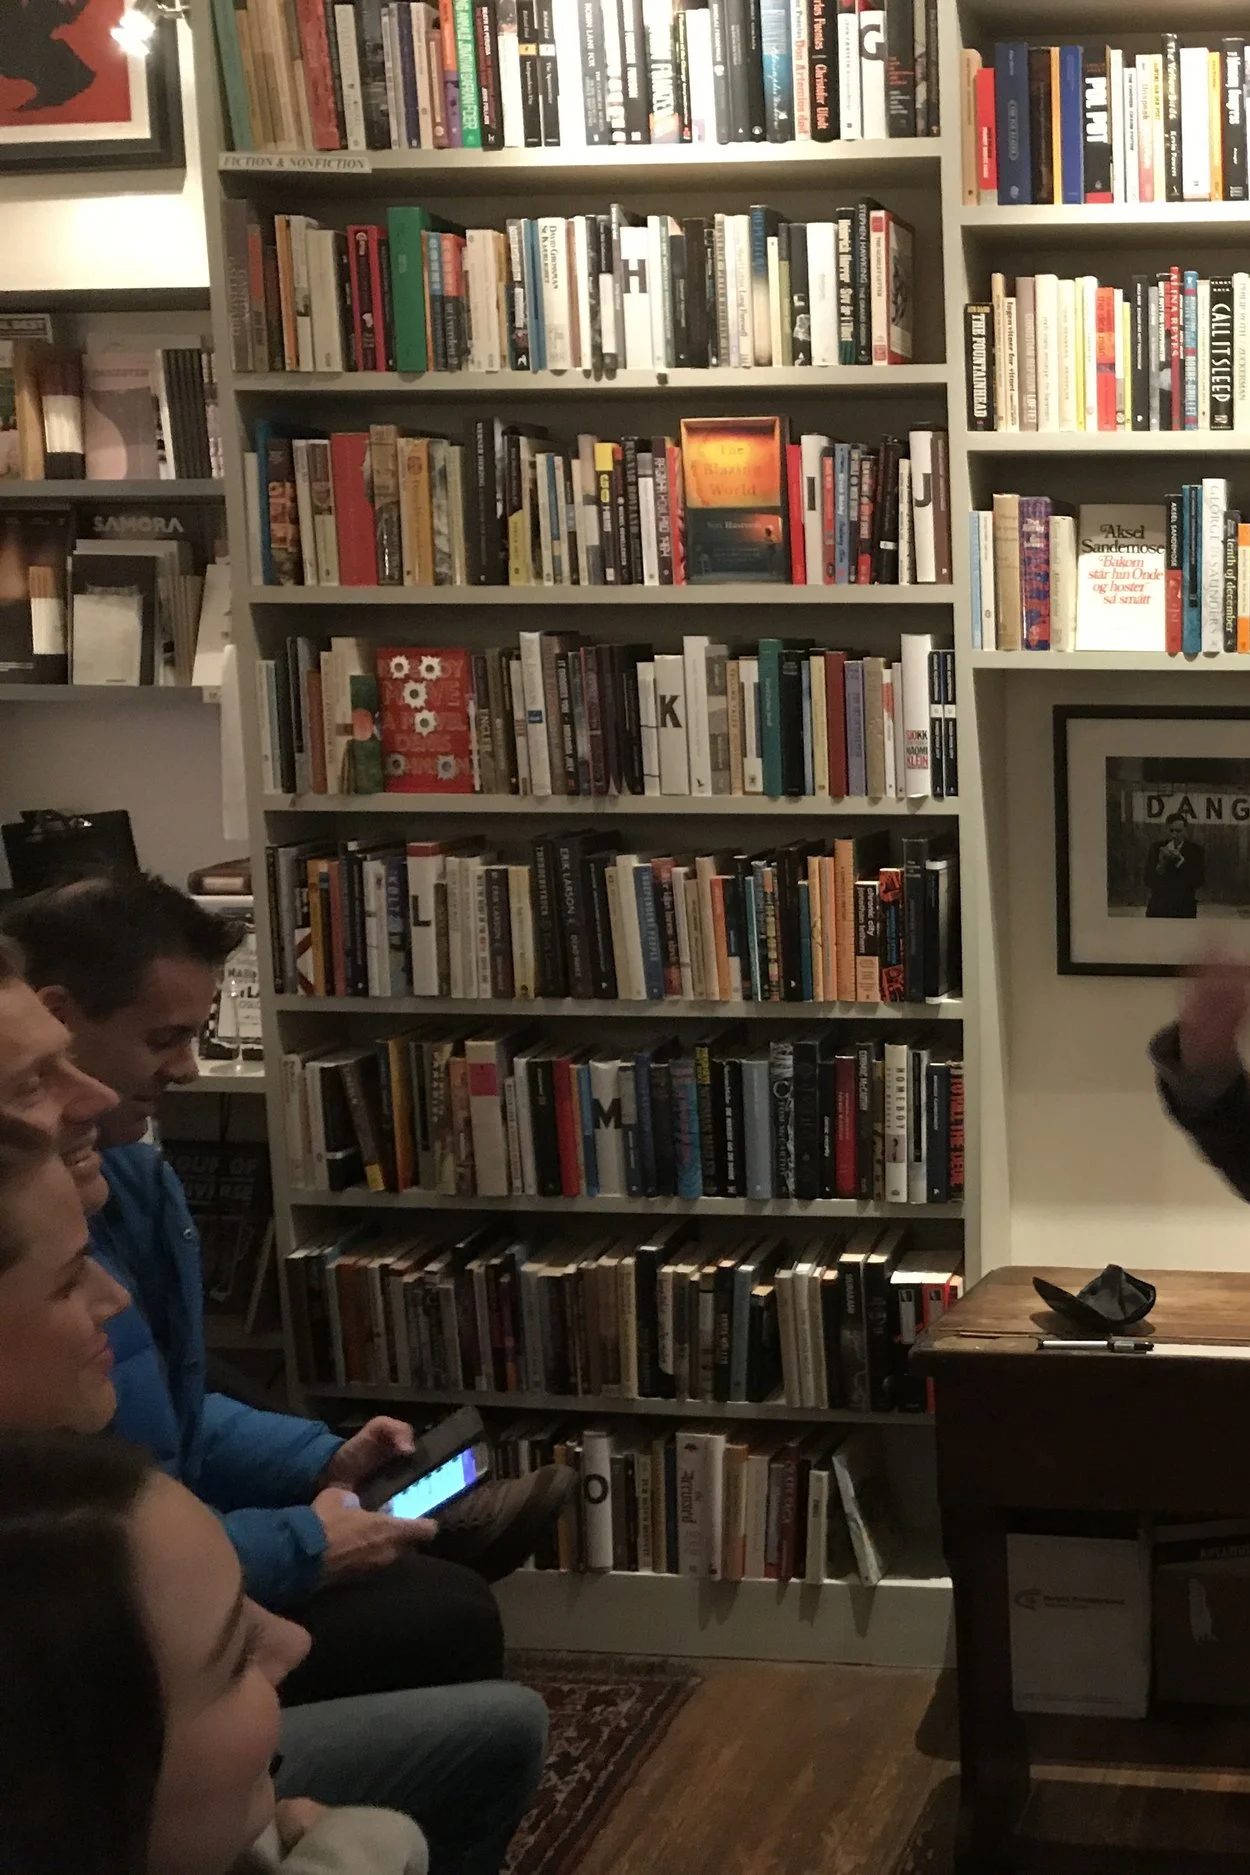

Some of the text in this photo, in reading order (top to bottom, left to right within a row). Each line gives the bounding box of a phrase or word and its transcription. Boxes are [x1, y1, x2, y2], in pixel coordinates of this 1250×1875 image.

[483, 34, 491, 55] PERUGIA
[583, 3, 595, 67] ROBIN LANE FOX
[815, 19, 825, 49] Fuentes
[860, 24, 887, 61] G
[1166, 42, 1176, 60] The
[463, 106, 477, 129] FOER
[1084, 77, 1108, 143] POL POT
[289, 157, 364, 169] NONFICTION
[858, 204, 868, 283] STEPHEN HAWKING
[623, 259, 647, 293] H
[1170, 316, 1179, 356] REYES
[1211, 304, 1230, 401] CALL IT SLEEP
[972, 314, 986, 416] THE FOUNTAINHEAD
[1238, 348, 1247, 400] ZUCKERMAN
[720, 444, 744, 455] The
[710, 484, 756, 496] World
[914, 473, 931, 508] J
[1082, 539, 1165, 554] Sandemose
[1100, 524, 1145, 539] Aksel
[1099, 555, 1144, 568] Bakom
[1133, 567, 1163, 580] Onde
[1208, 486, 1219, 634] GEORGE SAUNDERS
[1093, 582, 1107, 594] og
[1226, 538, 1236, 632] tenth of december
[660, 695, 682, 728] K
[560, 848, 571, 869] ERIK
[561, 872, 575, 914] LARSON
[412, 895, 431, 926] L
[857, 887, 867, 953] jonathan lethem
[865, 887, 875, 936] chronic city
[896, 1068, 905, 1130] HOMEBOY
[586, 1474, 609, 1504] O
